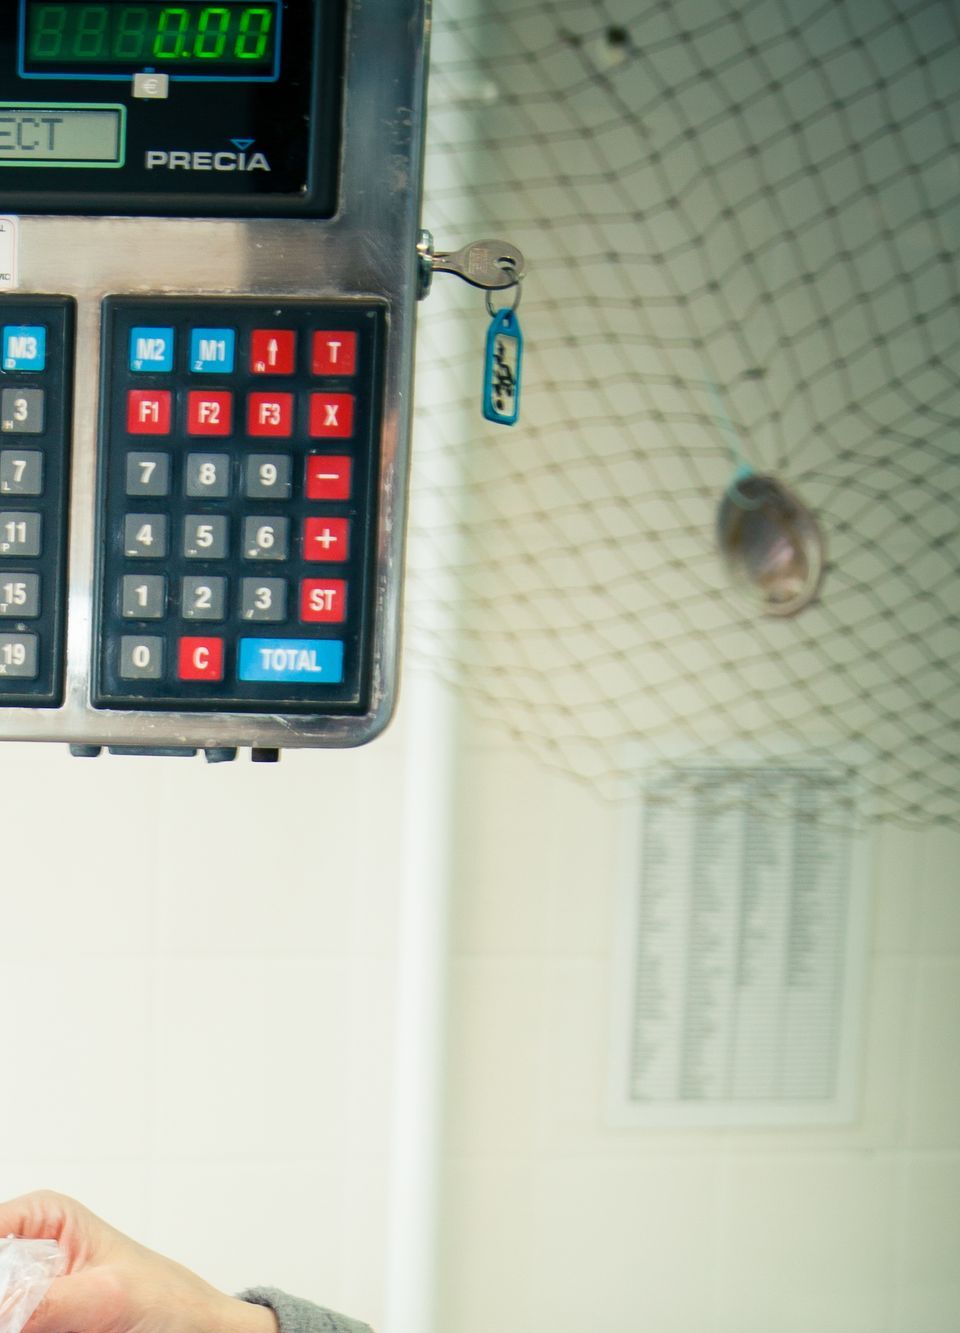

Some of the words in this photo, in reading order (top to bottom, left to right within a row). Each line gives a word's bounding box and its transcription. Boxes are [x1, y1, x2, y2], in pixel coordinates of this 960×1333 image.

[152, 8, 272, 59] 0.00
[143, 79, 159, 94] €
[145, 150, 272, 172] PRECIA
[8, 336, 38, 359] M3
[136, 338, 166, 361] M2
[198, 340, 226, 361] M1
[326, 341, 342, 363] T
[5, 359, 16, 368] D
[13, 399, 28, 421] 3
[140, 401, 159, 423] F1
[198, 402, 221, 424] F2
[259, 403, 281, 425] F3
[322, 404, 339, 427] X
[12, 460, 27, 482] 7
[138, 462, 157, 484] 7
[199, 463, 217, 485] 8
[259, 463, 278, 486] 9
[2, 481, 12, 491] L
[4, 521, 27, 544] 11
[136, 524, 154, 546] 4
[196, 525, 214, 547] 5
[256, 526, 275, 548] 6
[1, 543, 11, 553] P
[2, 582, 27, 606] 15
[134, 585, 148, 607] 1
[194, 586, 212, 608] 2
[254, 587, 273, 609] 3
[309, 588, 337, 612] ST
[0, 603, 9, 613] T
[1, 643, 26, 666] 19
[131, 645, 150, 668] 0
[192, 646, 210, 670] C
[258, 648, 323, 672] TOTAL
